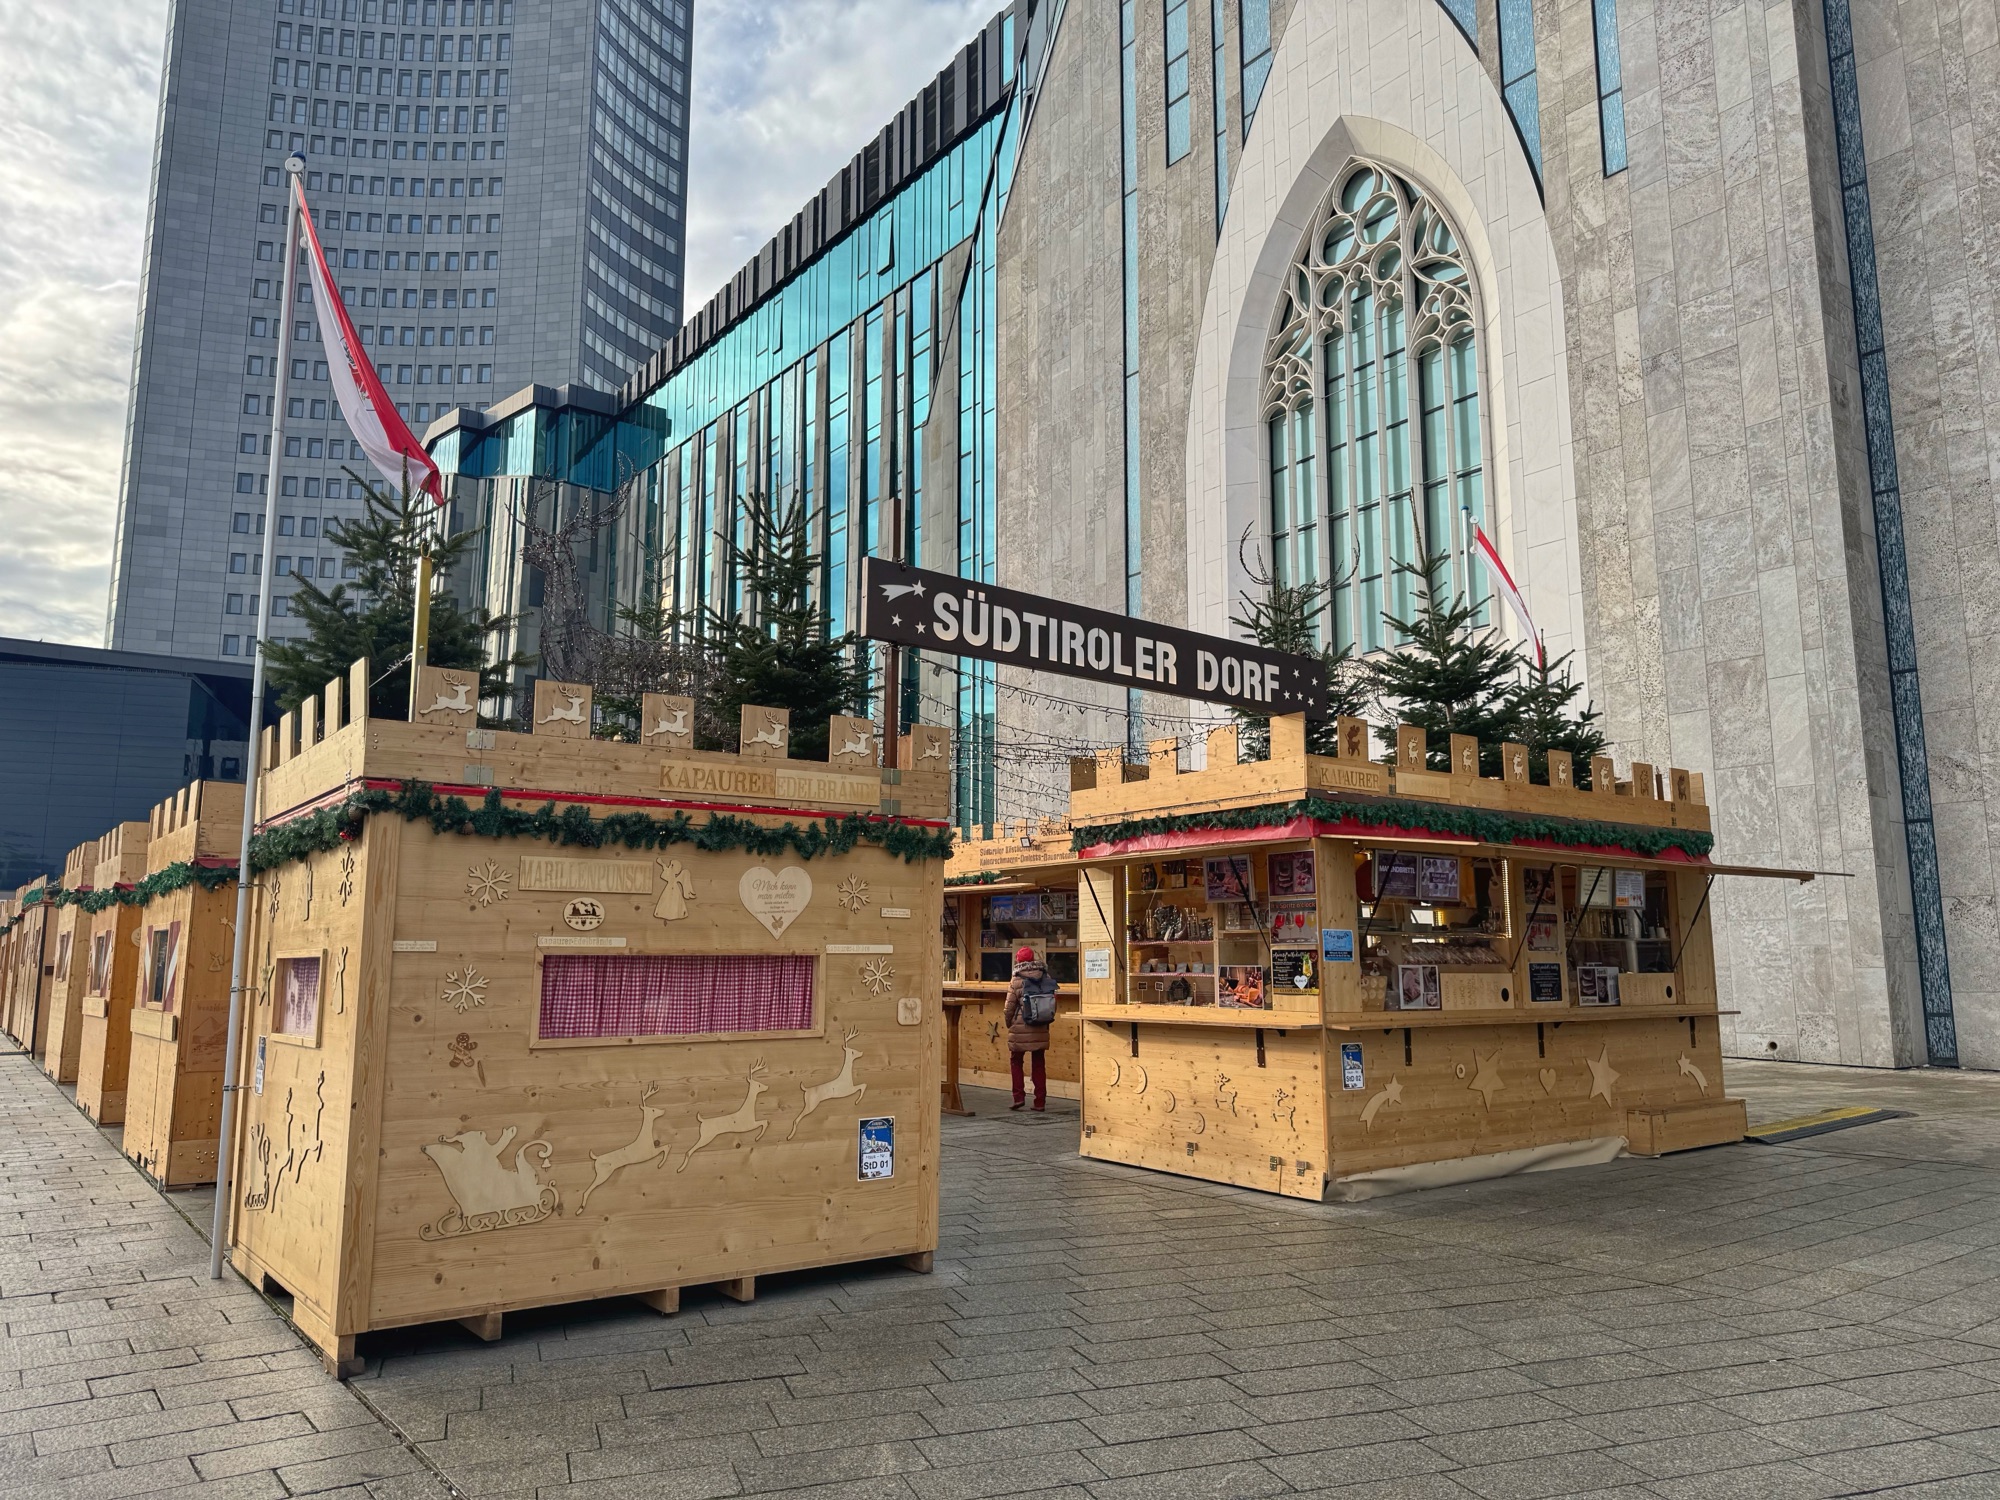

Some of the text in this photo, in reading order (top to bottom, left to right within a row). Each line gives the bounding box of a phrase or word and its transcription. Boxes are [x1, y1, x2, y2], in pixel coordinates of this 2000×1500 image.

[933, 591, 1280, 702] SÜDTIROLER DORF
[660, 765, 775, 794] KAPAURER
[1320, 767, 1379, 788] KAPAURER
[521, 860, 652, 891] MARILLENPUNSCH
[752, 879, 797, 891] Mich kann
[863, 1160, 889, 1170] StD 01
